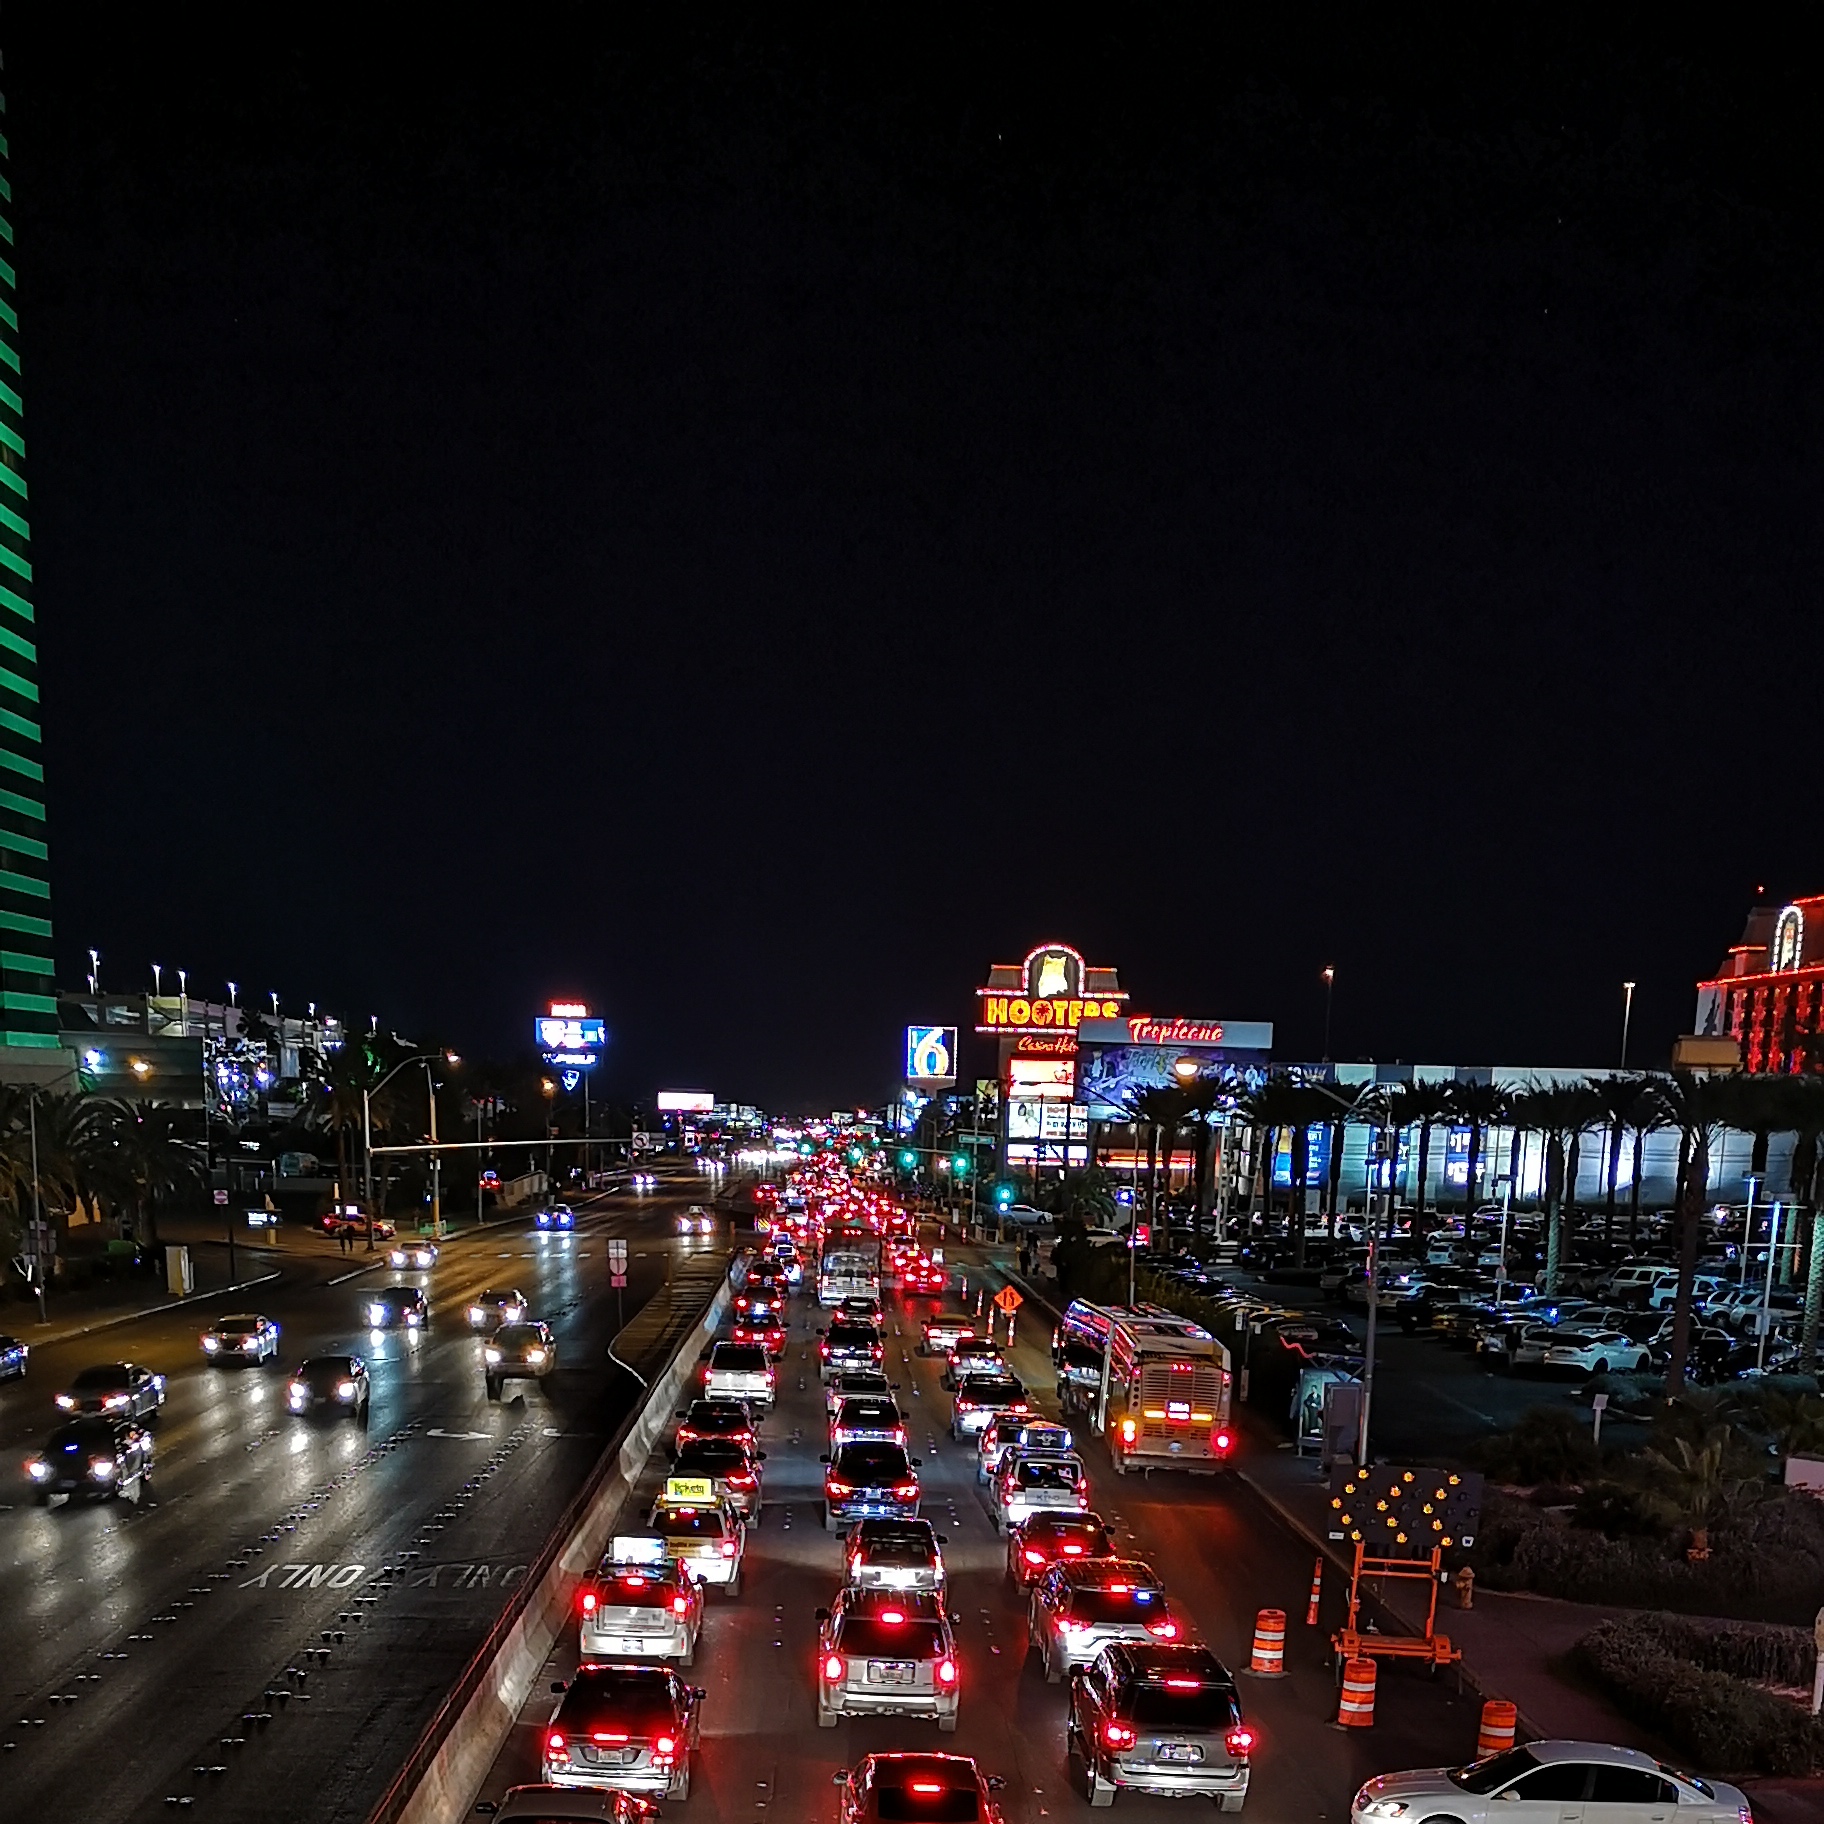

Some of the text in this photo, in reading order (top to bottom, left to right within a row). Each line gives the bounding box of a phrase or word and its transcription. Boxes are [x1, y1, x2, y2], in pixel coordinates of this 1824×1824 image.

[987, 998, 1120, 1027] HOOTERS
[1128, 1017, 1223, 1044] Tropicana
[913, 1027, 949, 1077] 6
[238, 1564, 366, 1590] ONLY
